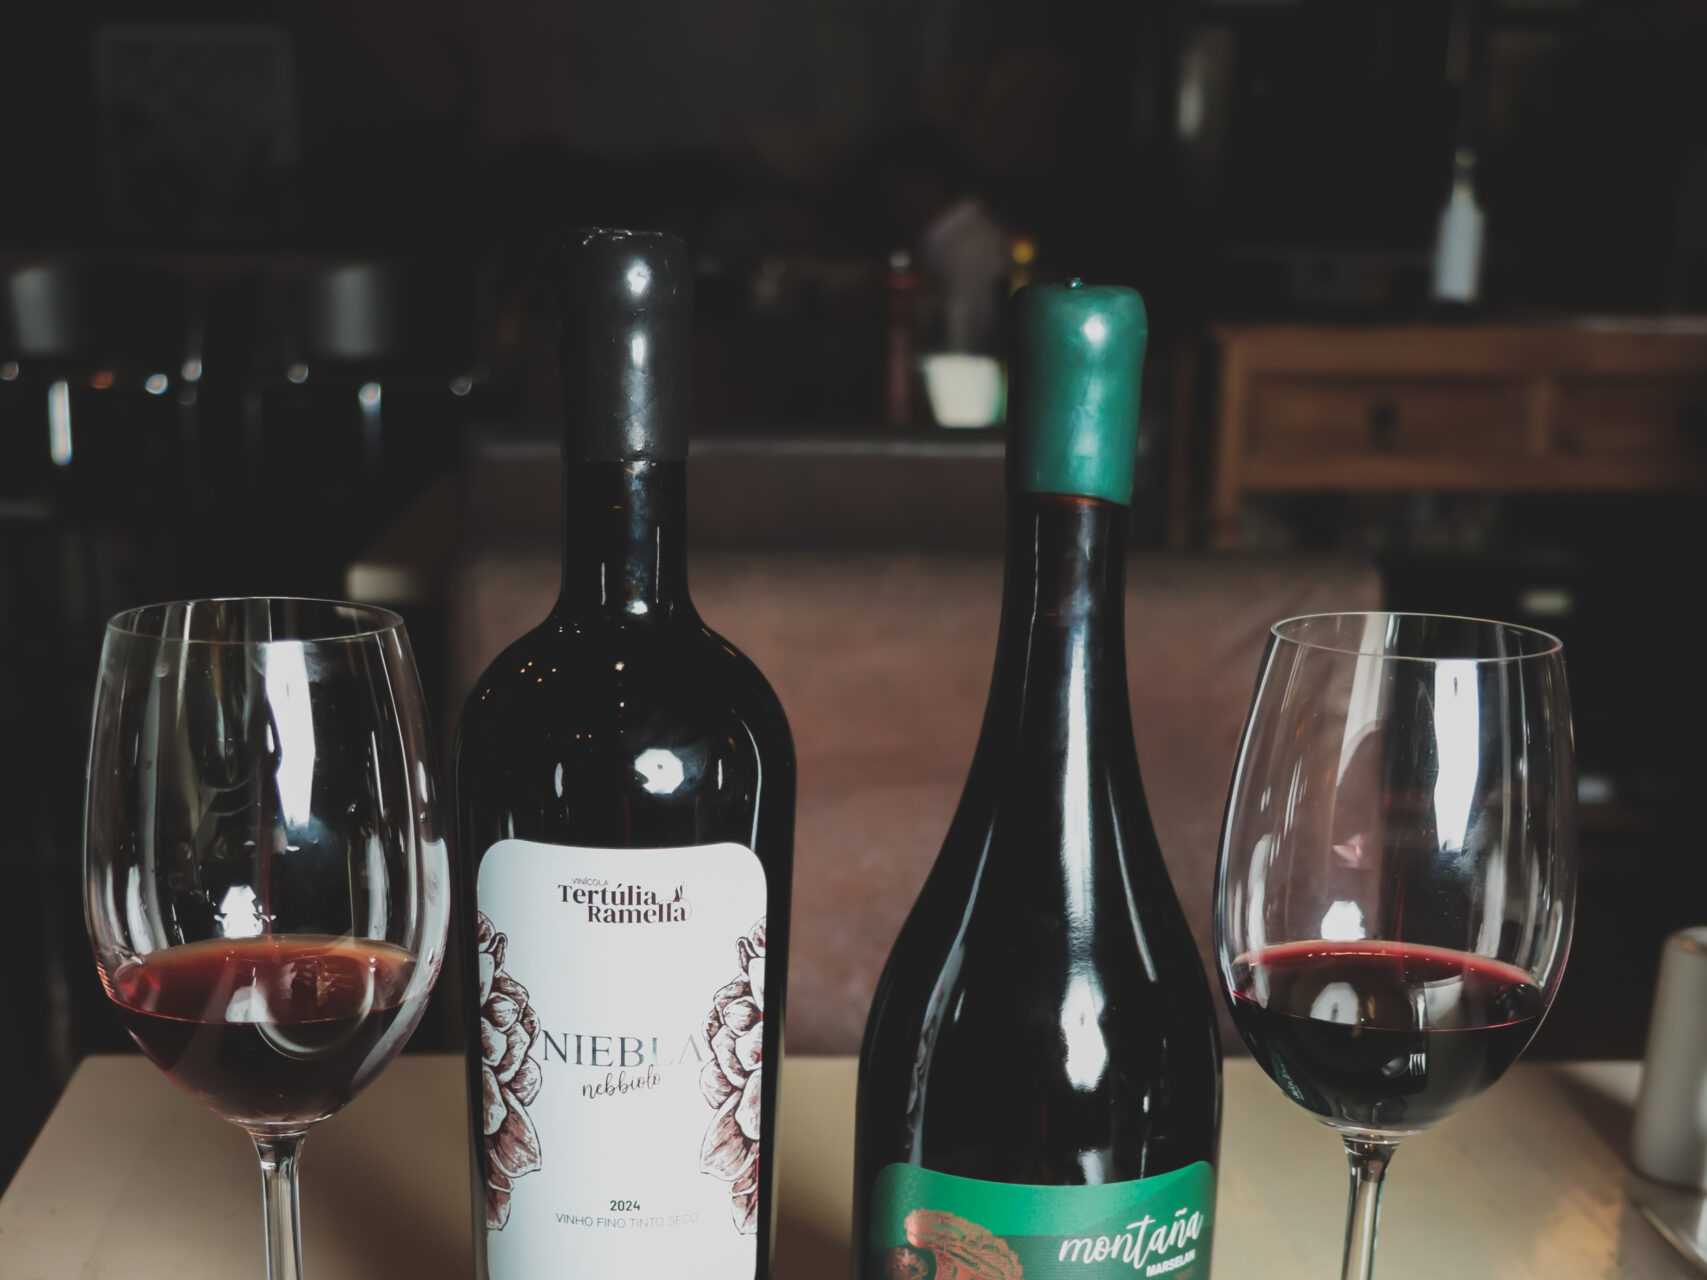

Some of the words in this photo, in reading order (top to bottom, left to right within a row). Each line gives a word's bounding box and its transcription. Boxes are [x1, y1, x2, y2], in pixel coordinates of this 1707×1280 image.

[557, 883, 659, 906] Tertúlia
[588, 902, 687, 923] Ramella
[541, 1030, 703, 1067] NIEBLA
[582, 1064, 661, 1099] nebbiolo
[610, 1200, 641, 1212] 2024
[555, 1212, 593, 1227] VINHO
[597, 1217, 626, 1228] FINO
[630, 1216, 664, 1228] TINTO
[667, 1212, 698, 1226] SECO
[1058, 1207, 1204, 1269] montaña
[1146, 1249, 1196, 1277] MARSELAN
